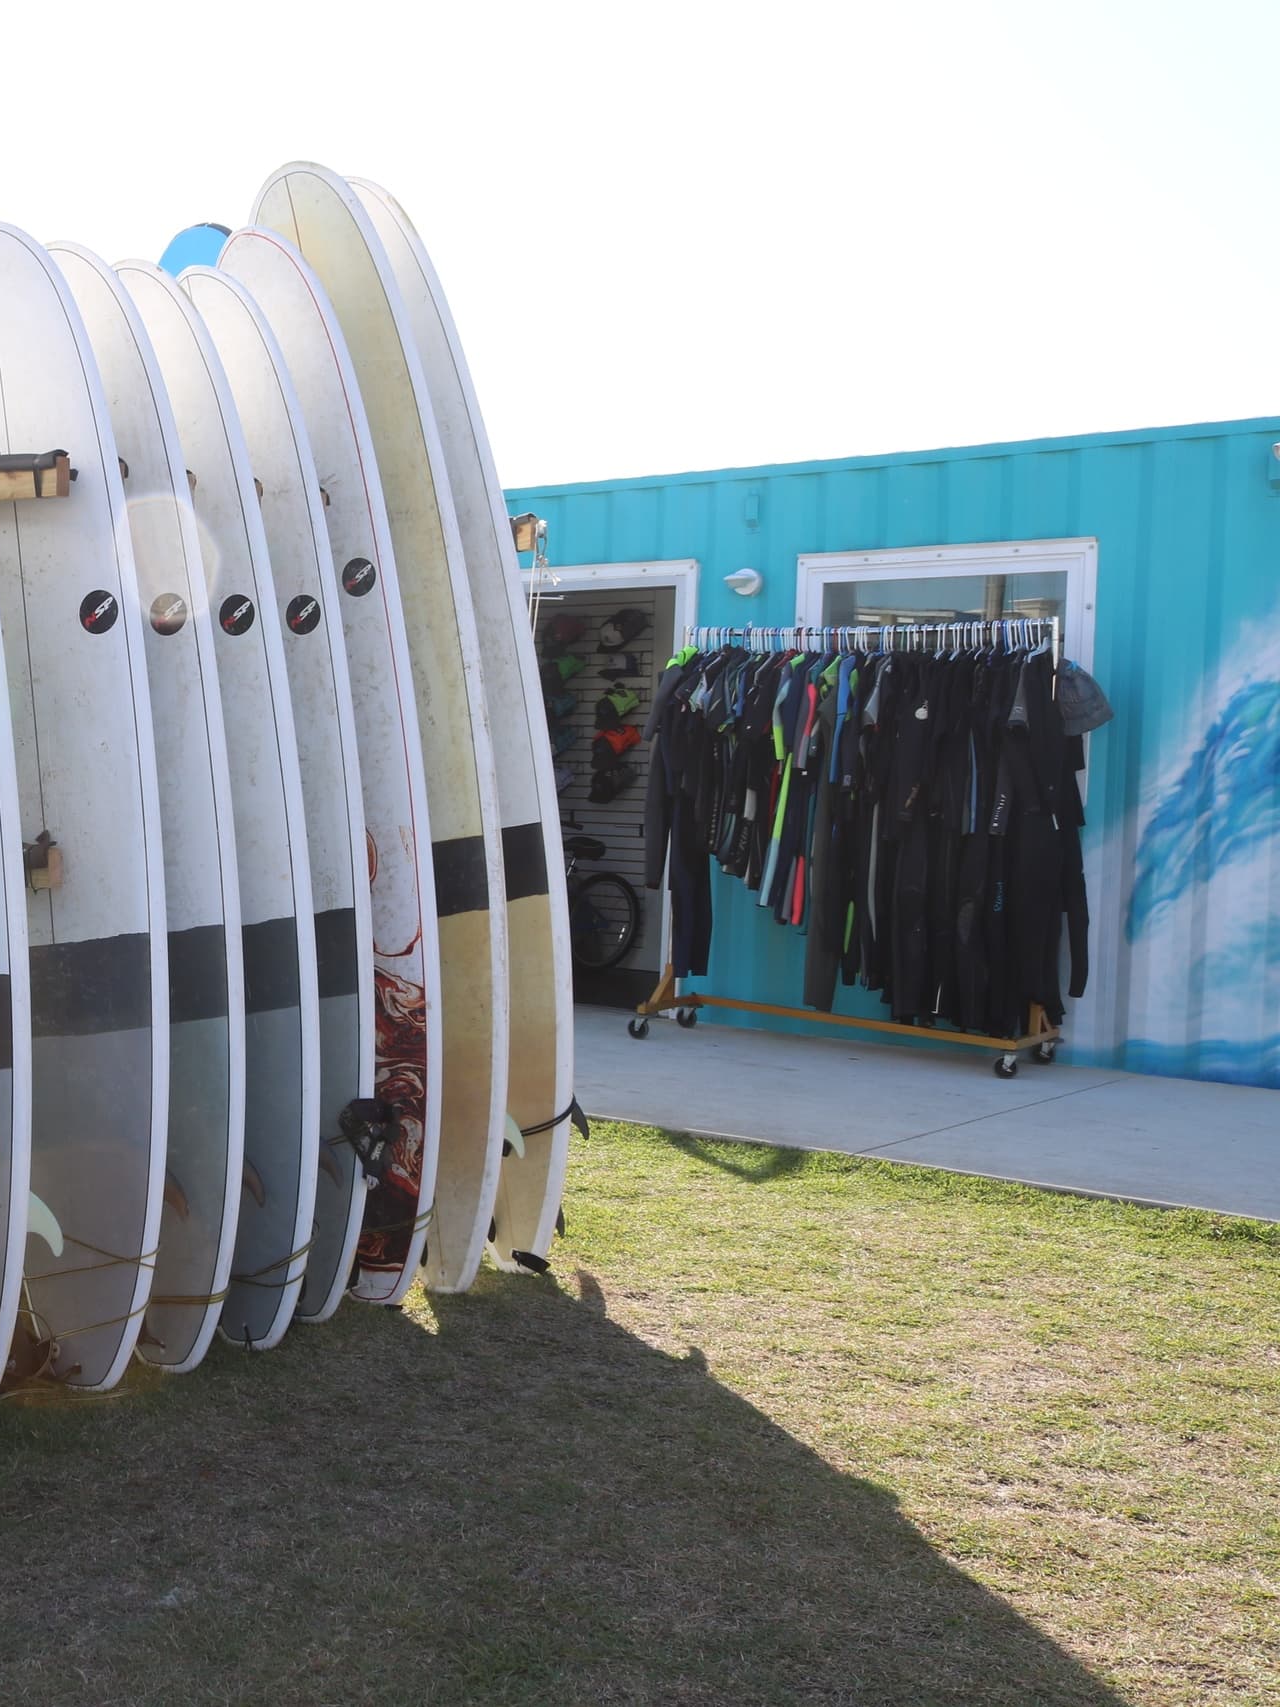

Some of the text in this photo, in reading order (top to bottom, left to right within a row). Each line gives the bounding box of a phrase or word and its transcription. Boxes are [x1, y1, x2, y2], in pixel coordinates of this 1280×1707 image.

[346, 563, 372, 590] NSP
[84, 596, 114, 629] NSP
[154, 600, 183, 627] NSP
[223, 600, 252, 629] NSP
[291, 600, 318, 629] NSP
